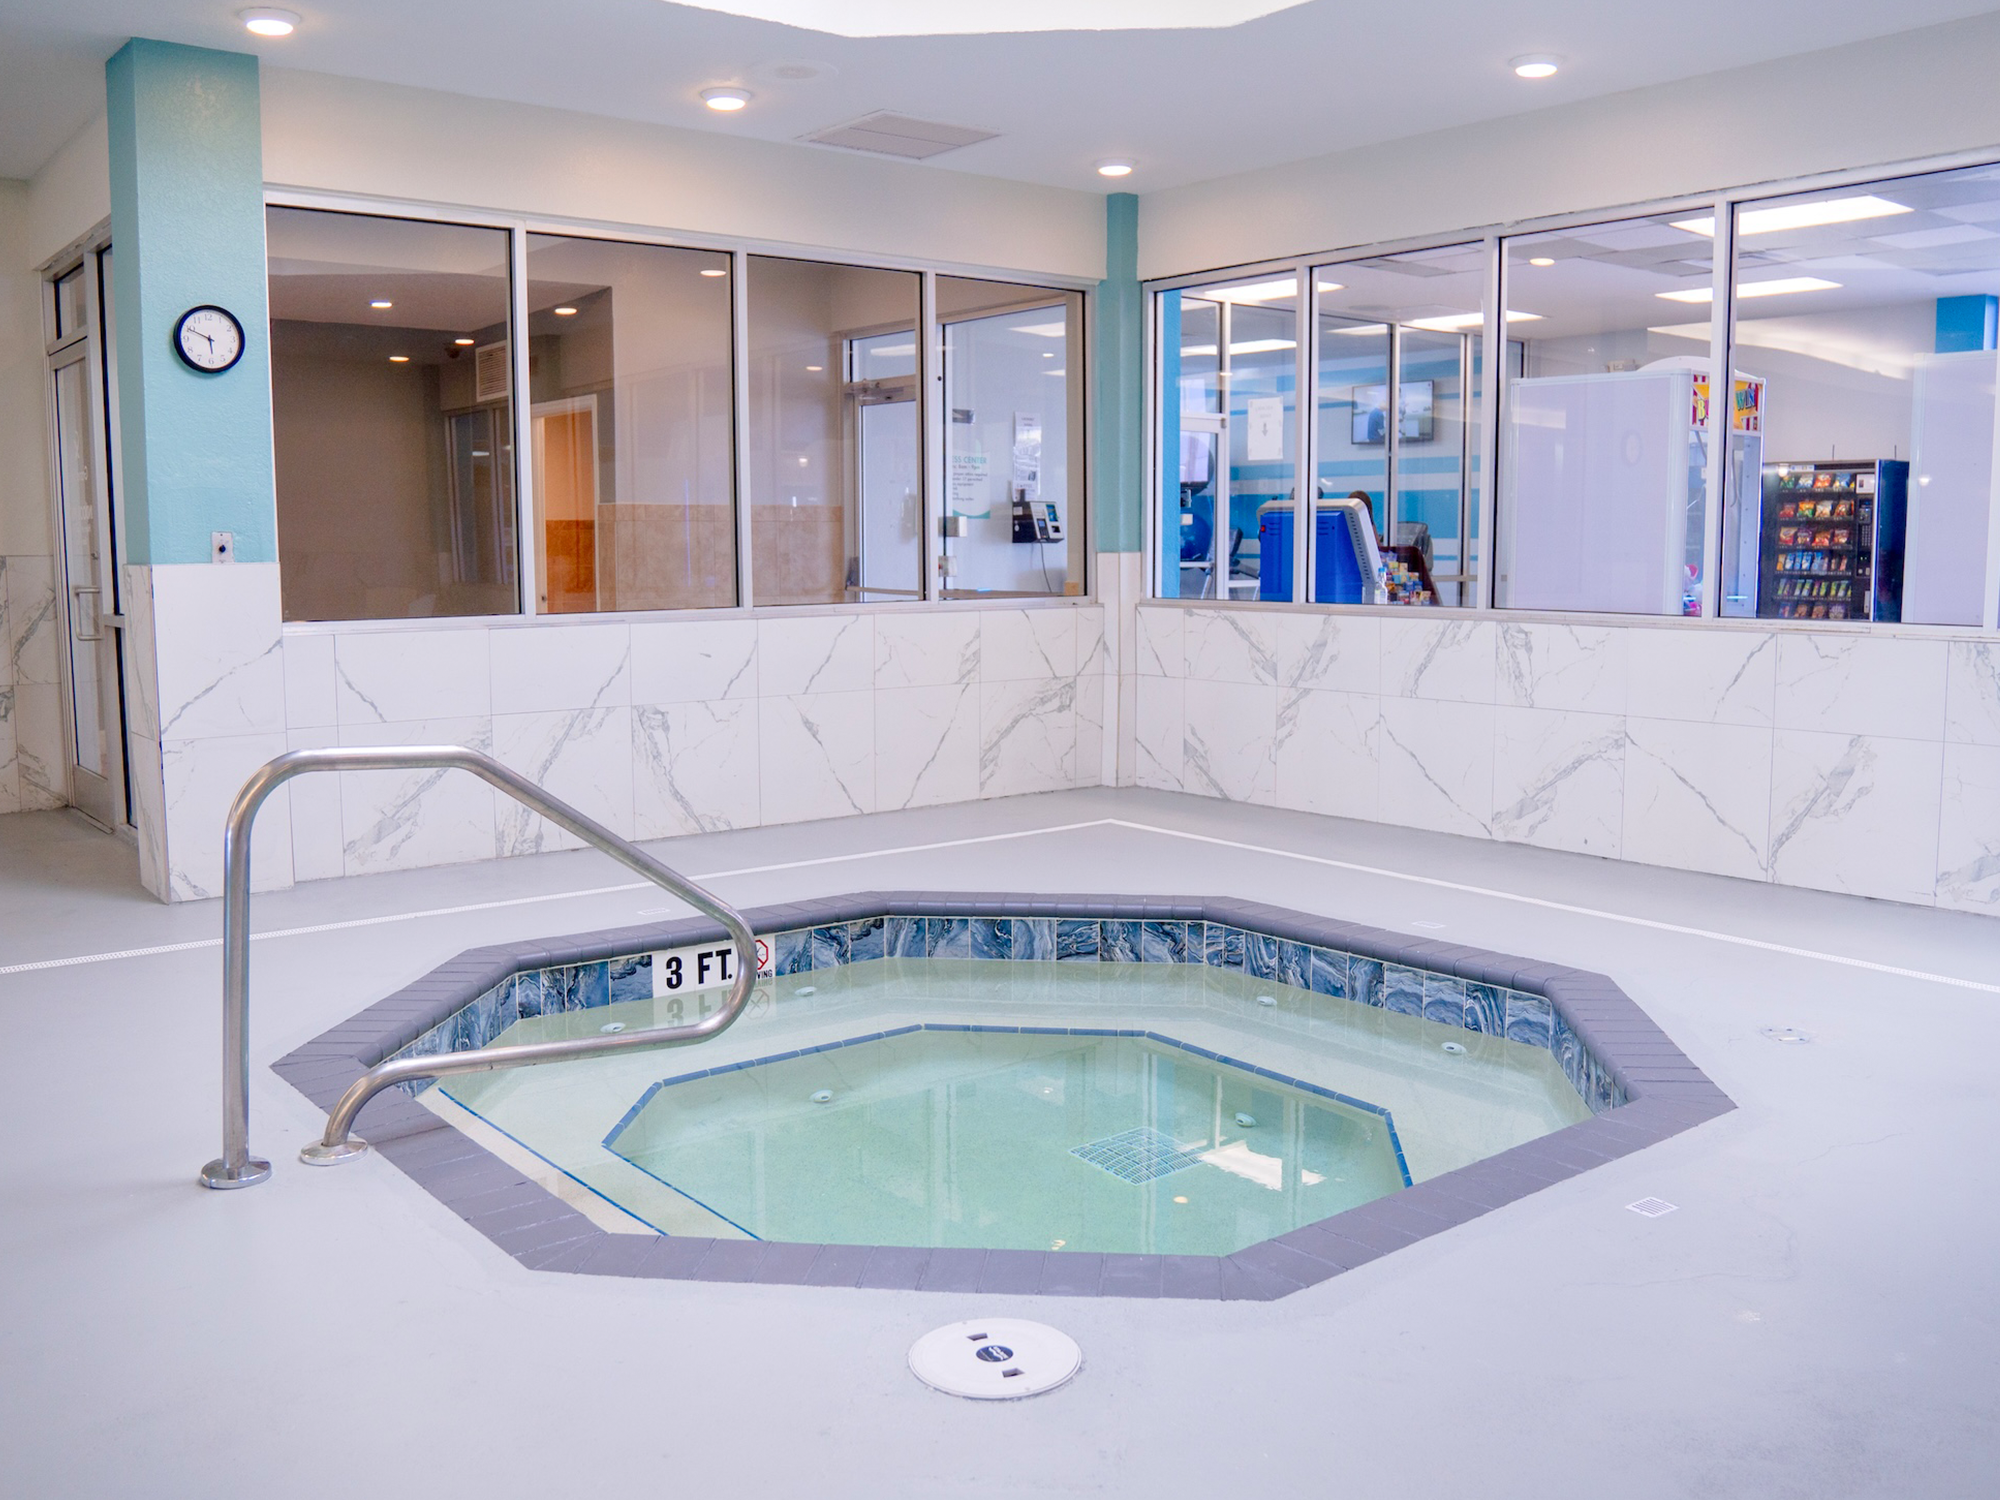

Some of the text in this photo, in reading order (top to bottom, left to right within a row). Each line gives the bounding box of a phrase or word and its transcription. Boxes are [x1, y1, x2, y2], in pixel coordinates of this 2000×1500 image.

[197, 354, 202, 362] 7
[220, 354, 226, 362] 5
[963, 456, 987, 464] CENTER
[666, 948, 733, 989] 3 FT.
